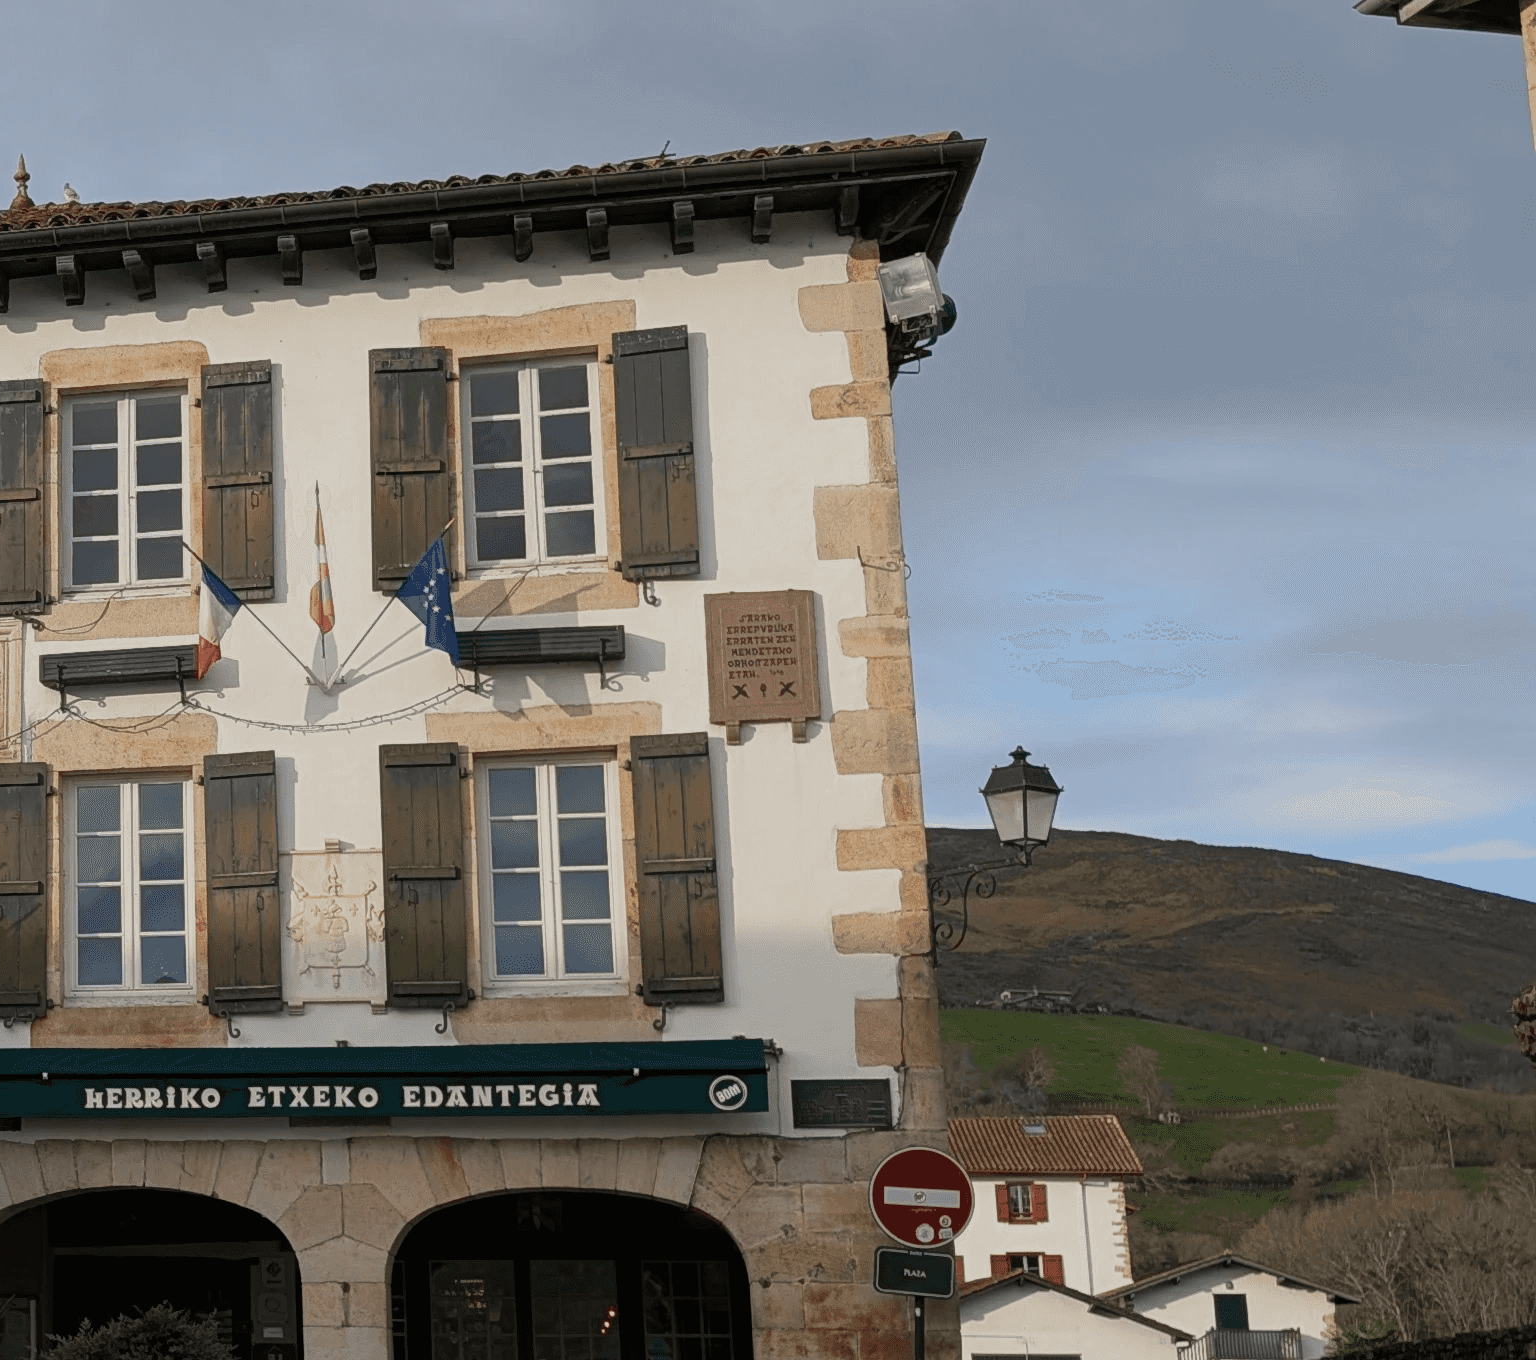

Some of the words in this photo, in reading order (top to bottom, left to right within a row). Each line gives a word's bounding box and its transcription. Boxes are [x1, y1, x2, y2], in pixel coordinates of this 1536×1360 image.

[726, 636, 774, 645] ERRATEN
[775, 635, 796, 644] ZEN
[247, 1086, 379, 1108] ETXEKO
